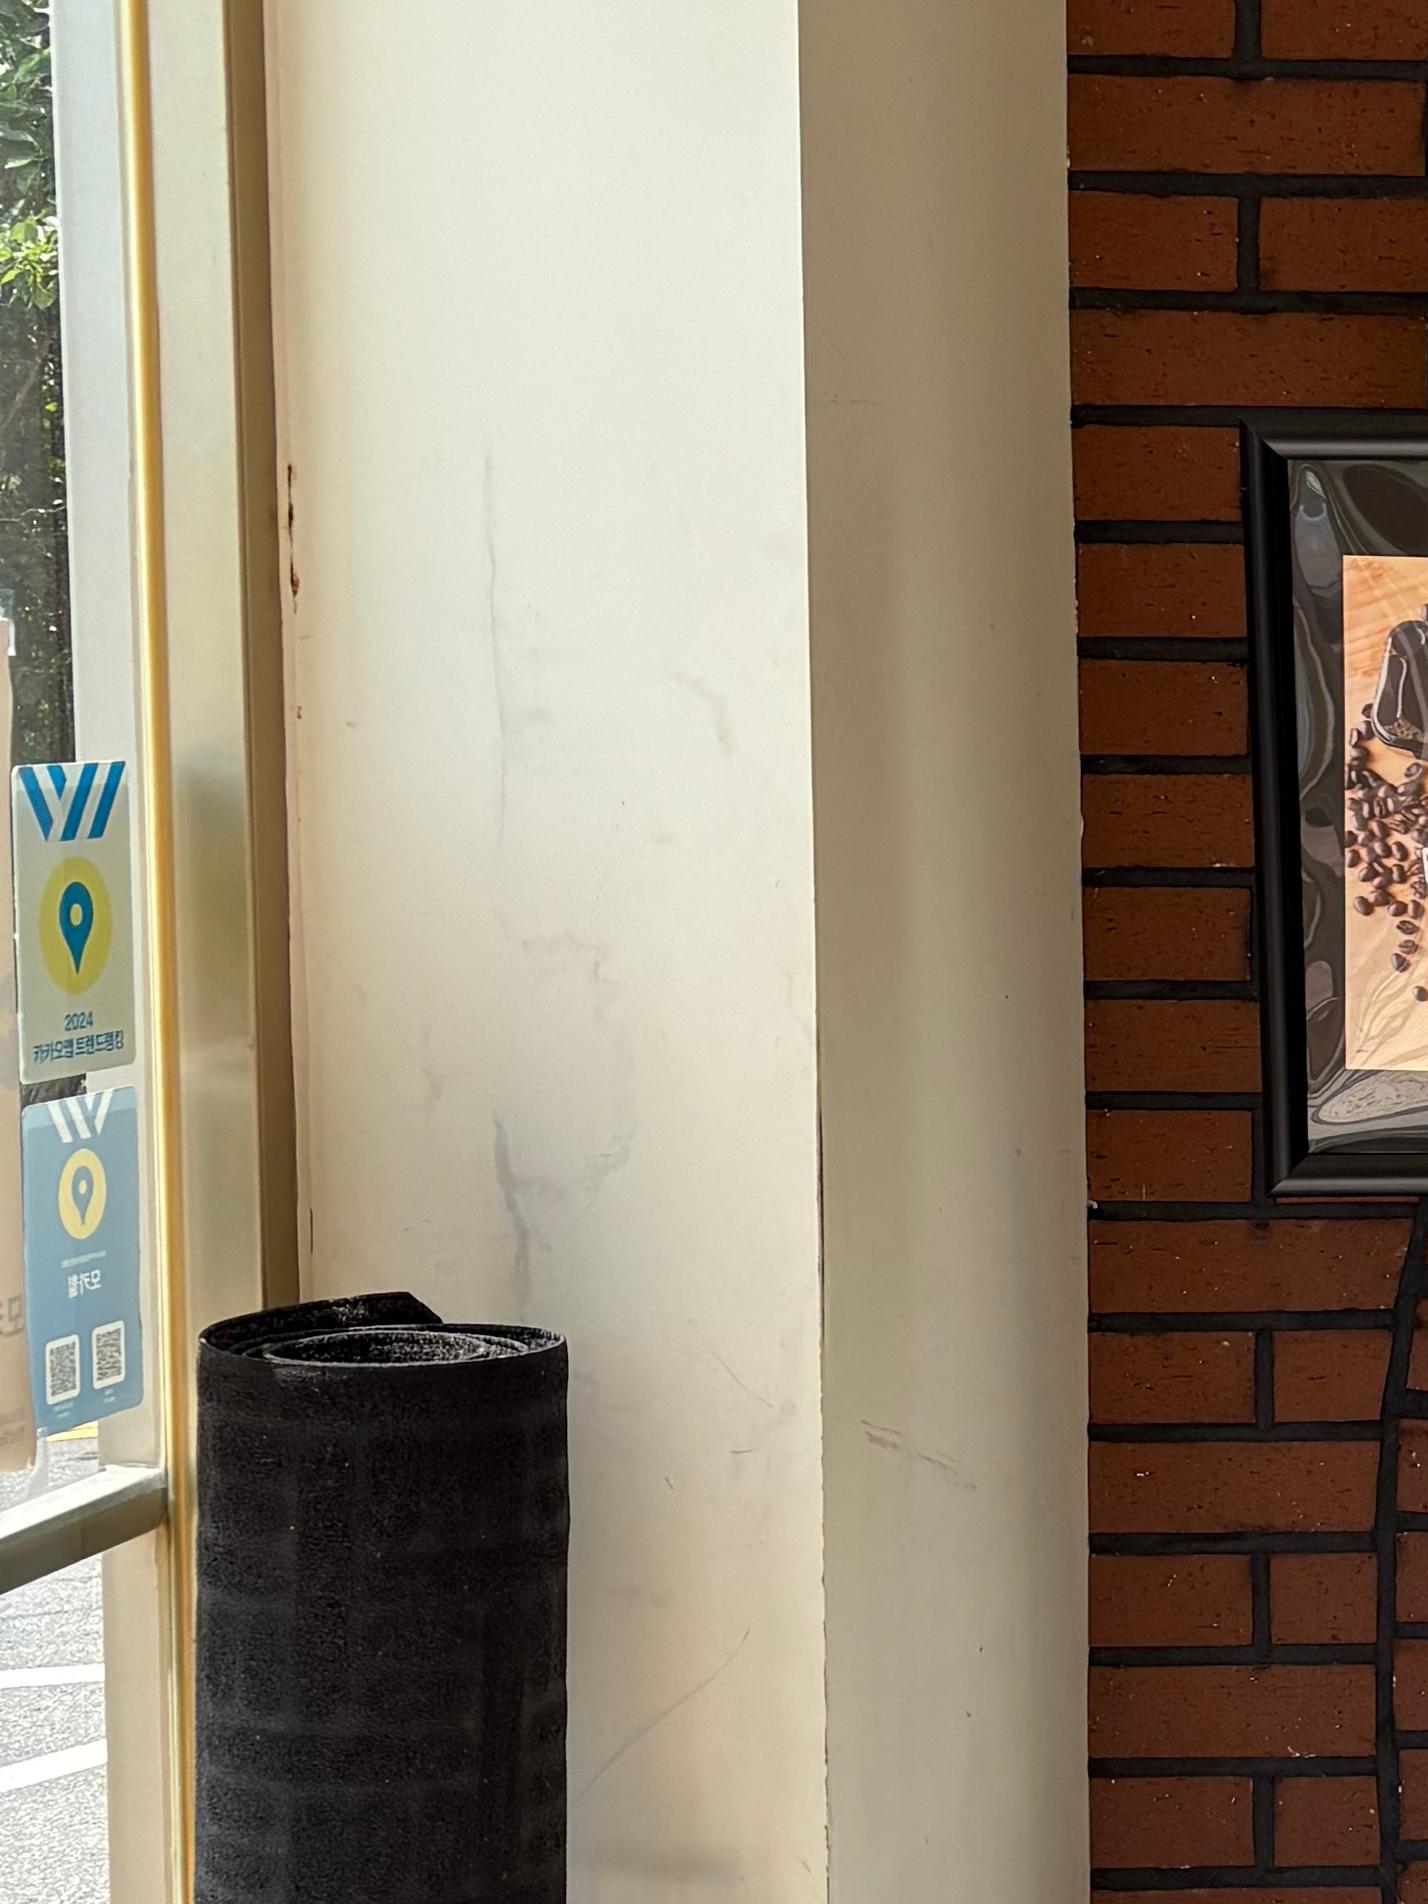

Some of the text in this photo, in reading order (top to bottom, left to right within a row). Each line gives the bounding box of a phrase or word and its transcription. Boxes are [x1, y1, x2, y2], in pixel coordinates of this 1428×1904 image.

[63, 1011, 94, 1032] 2024
[32, 1029, 124, 1064] 카카오맵 트렌드랭킹
